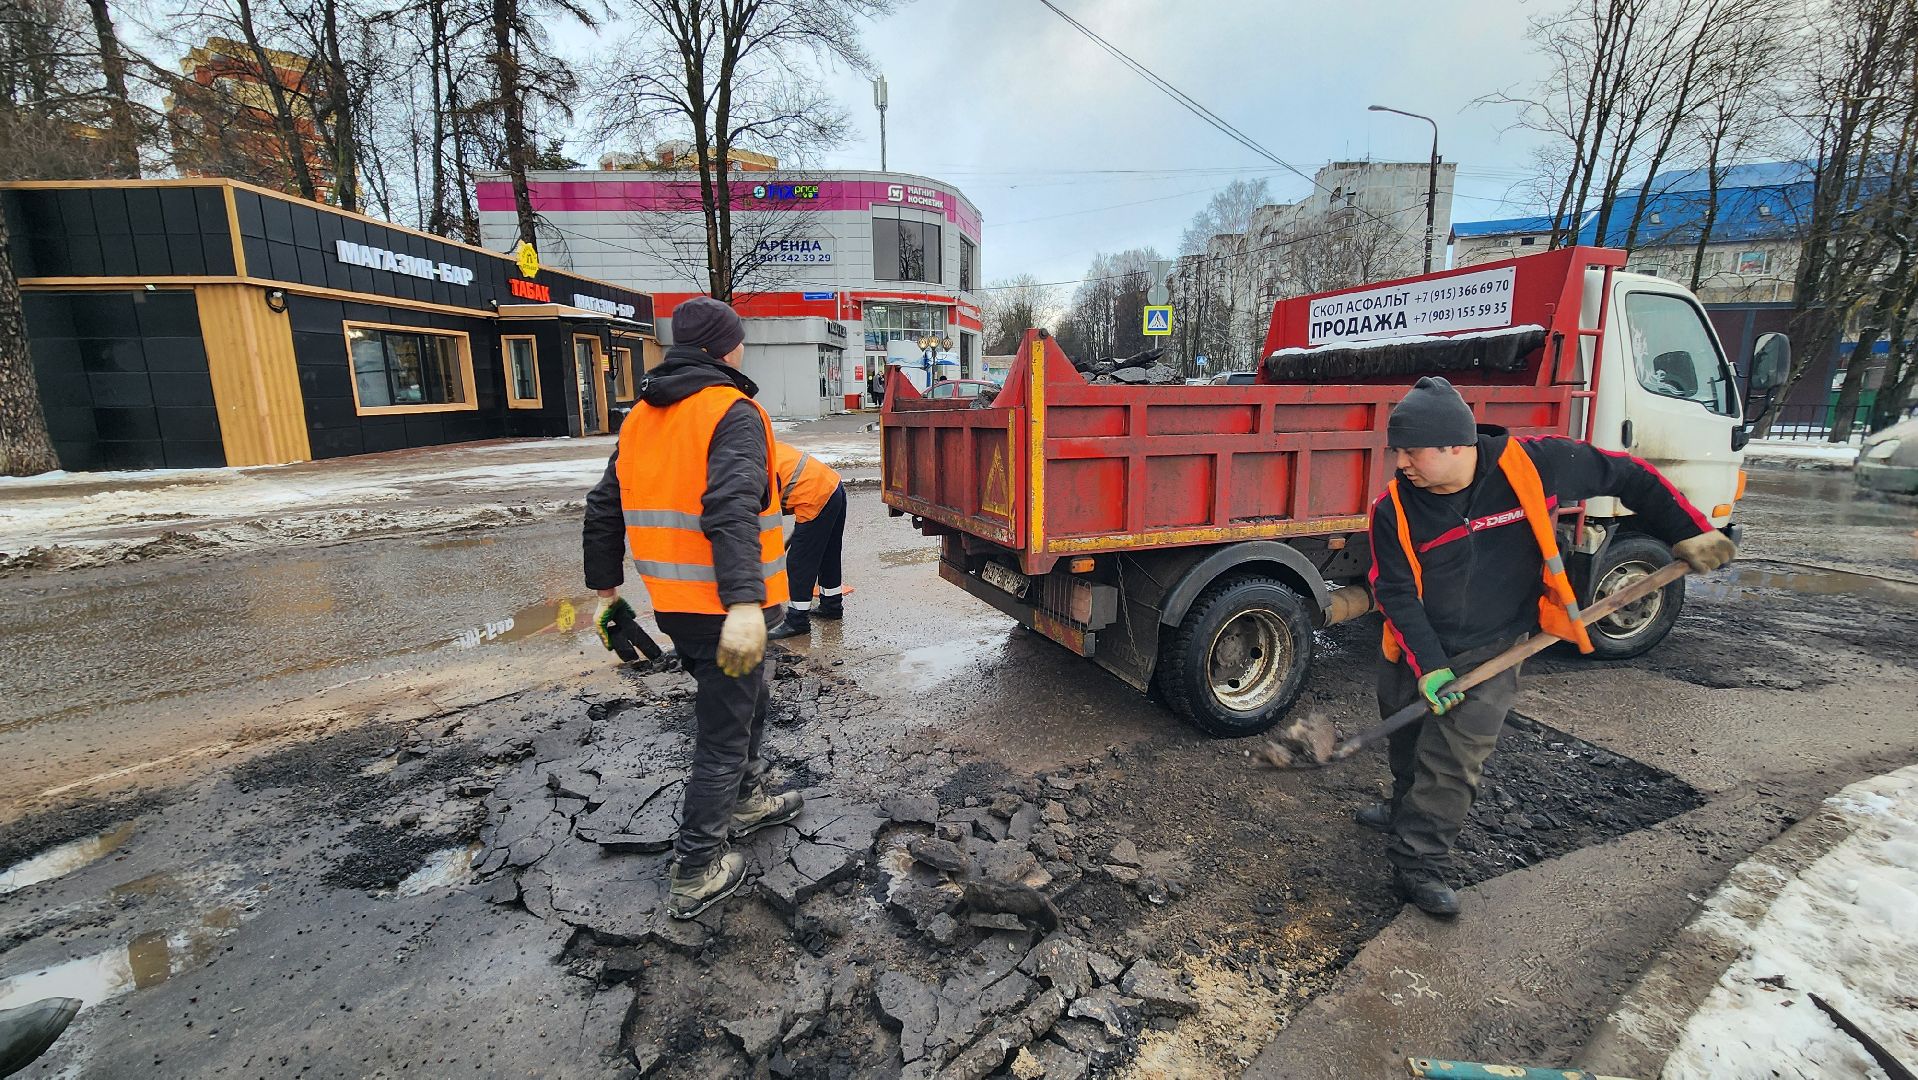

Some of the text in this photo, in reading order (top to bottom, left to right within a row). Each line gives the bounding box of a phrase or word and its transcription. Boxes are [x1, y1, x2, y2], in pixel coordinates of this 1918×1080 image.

[908, 186, 935, 198] МАГНИТ
[908, 195, 944, 209] КОСМЕТИК
[759, 240, 822, 253] АРЕНДА
[336, 240, 473, 286] МАГАЗИН-БАР
[781, 254, 800, 262] 242
[803, 254, 816, 262] 39
[818, 254, 831, 262] 29
[510, 278, 550, 303] ТАБАК
[1313, 279, 1509, 317] СКОЛ АСФАЛЬТ +7 (915) 366 69 70
[573, 293, 635, 318] МАГАЗИН-БАР
[1312, 301, 1507, 339] ПРОДАЖА +7 (903) 155 59 35
[1486, 509, 1526, 527] DEMI
